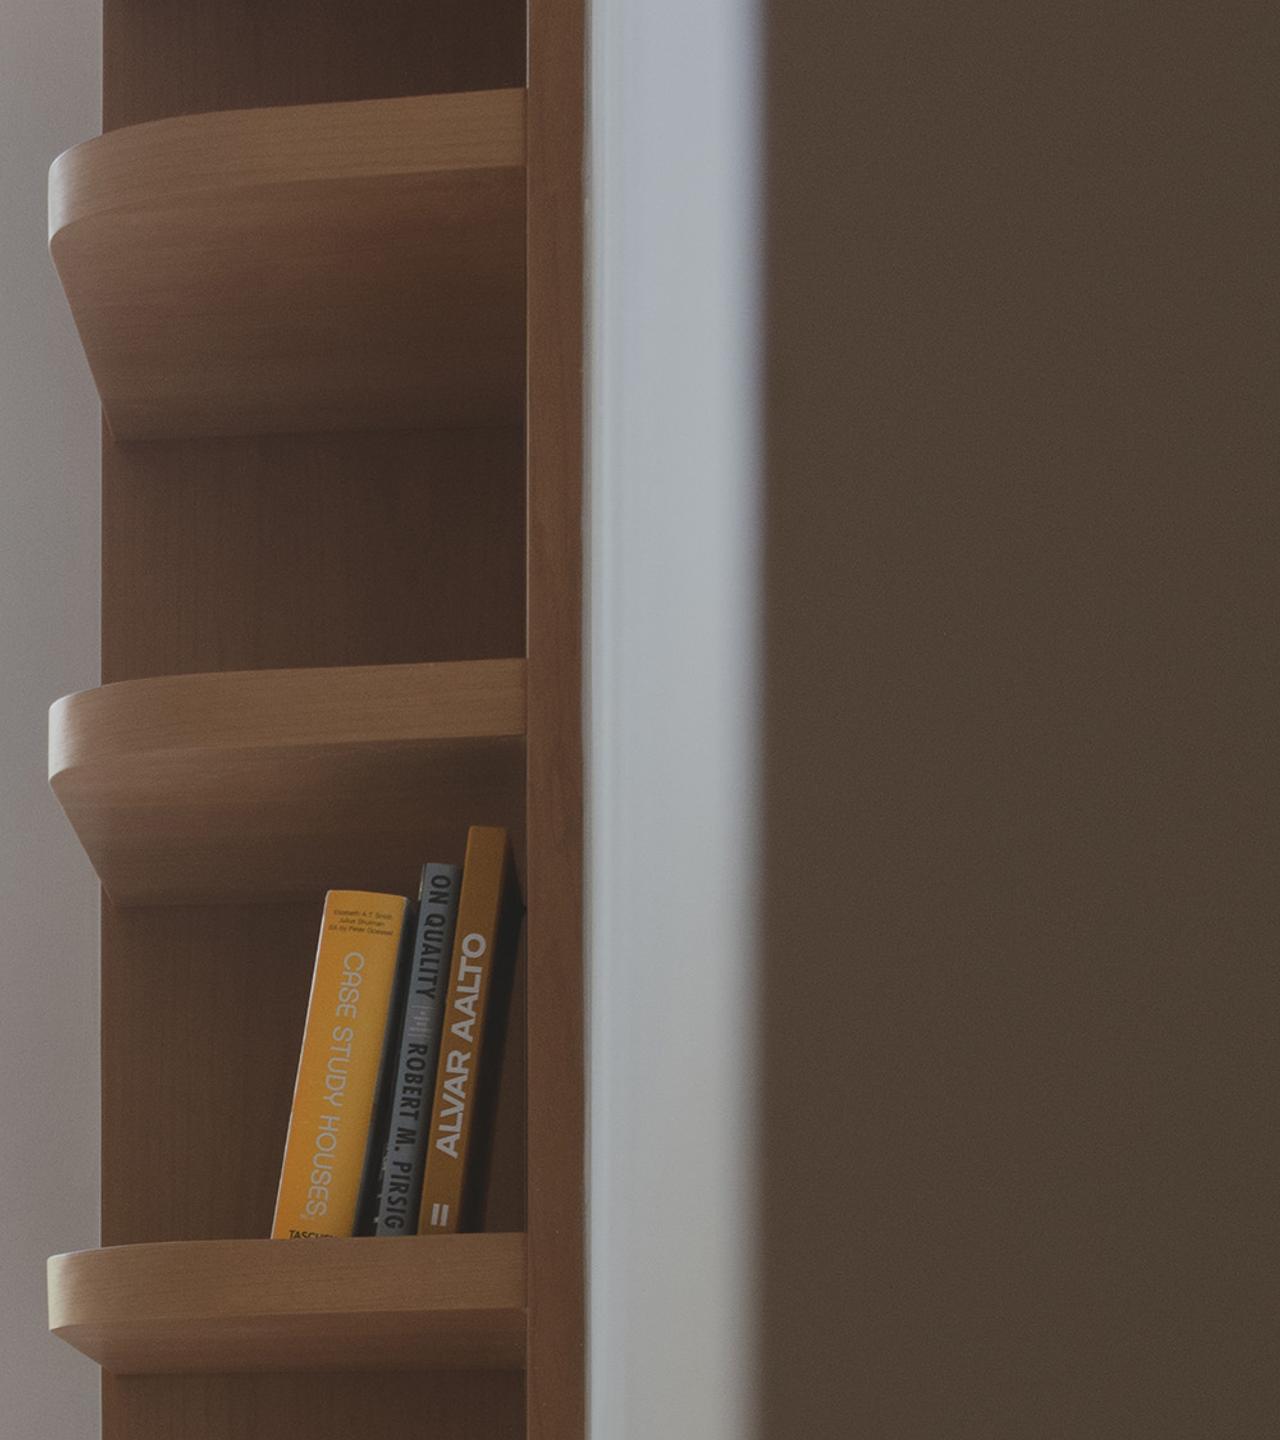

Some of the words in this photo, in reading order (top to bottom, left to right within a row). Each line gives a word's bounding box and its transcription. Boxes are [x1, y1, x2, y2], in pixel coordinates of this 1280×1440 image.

[429, 874, 451, 905] ON
[336, 951, 365, 1019] CASE
[416, 913, 446, 1000] QUALITY
[451, 932, 487, 1043] AALTO
[323, 1026, 353, 1108] STUDY
[399, 1042, 428, 1120] ROBERT
[435, 1050, 472, 1160] ALVAR
[305, 1114, 340, 1217] HOUSES
[394, 1126, 417, 1152] M.
[384, 1161, 413, 1229] PIRSIG
[289, 1230, 333, 1240] TASC
